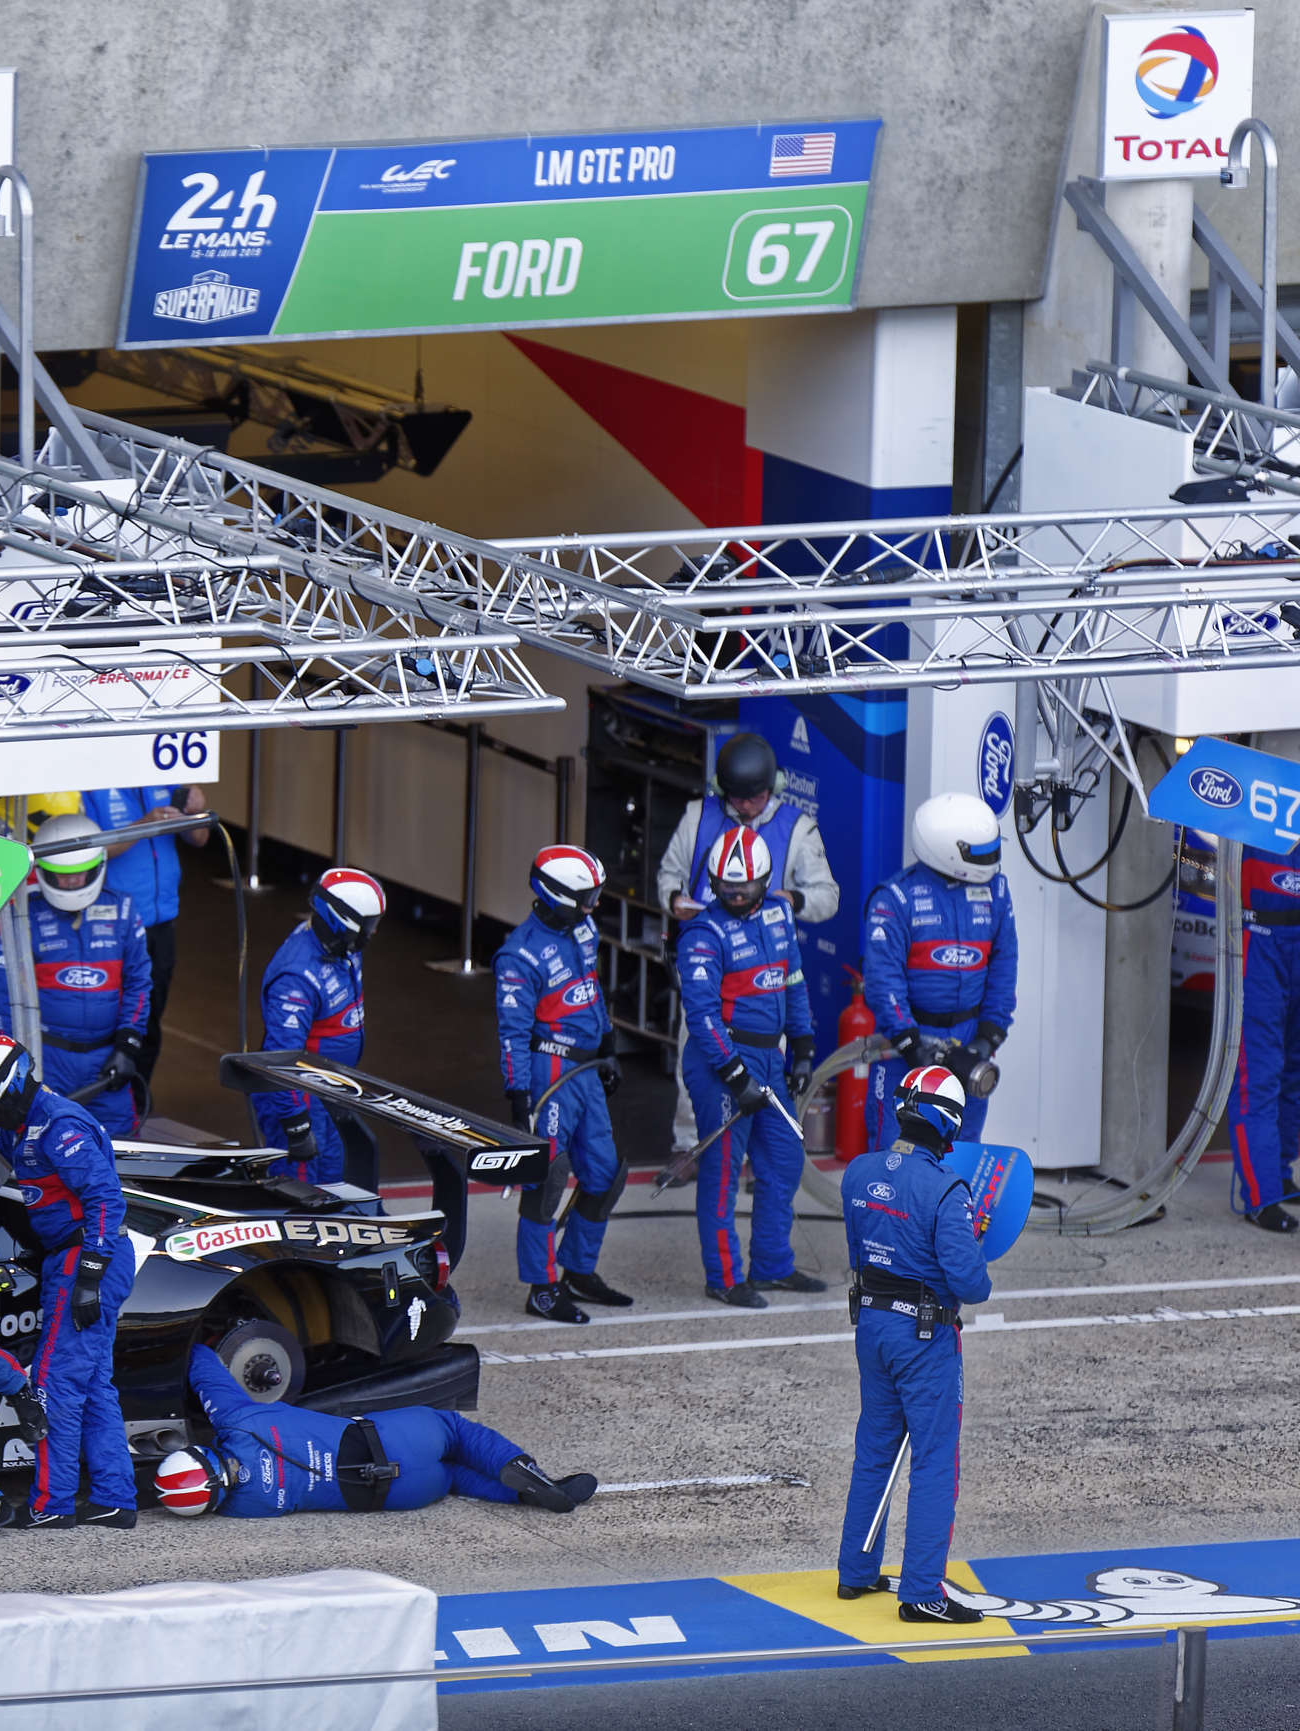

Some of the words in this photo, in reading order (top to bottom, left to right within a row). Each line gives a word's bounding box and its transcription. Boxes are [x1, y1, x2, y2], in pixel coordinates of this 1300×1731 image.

[380, 159, 457, 182] WEC
[535, 150, 574, 187] LM
[578, 147, 624, 185] GTE
[628, 145, 676, 183] PRO
[165, 170, 278, 231] 24h
[158, 233, 193, 250] LE
[194, 230, 268, 249] MANS
[746, 220, 836, 287] 67
[452, 237, 583, 301] FORD
[155, 284, 260, 321] SUPERFINALE
[152, 730, 208, 772] 66
[985, 731, 1012, 801] Ford
[1197, 770, 1234, 804] Ford
[941, 949, 975, 964] Ford
[64, 969, 99, 985] Ford
[548, 1101, 560, 1136] FORD
[471, 1149, 541, 1171] GT
[195, 1222, 272, 1251] Castrol
[284, 1220, 414, 1245] EDGE
